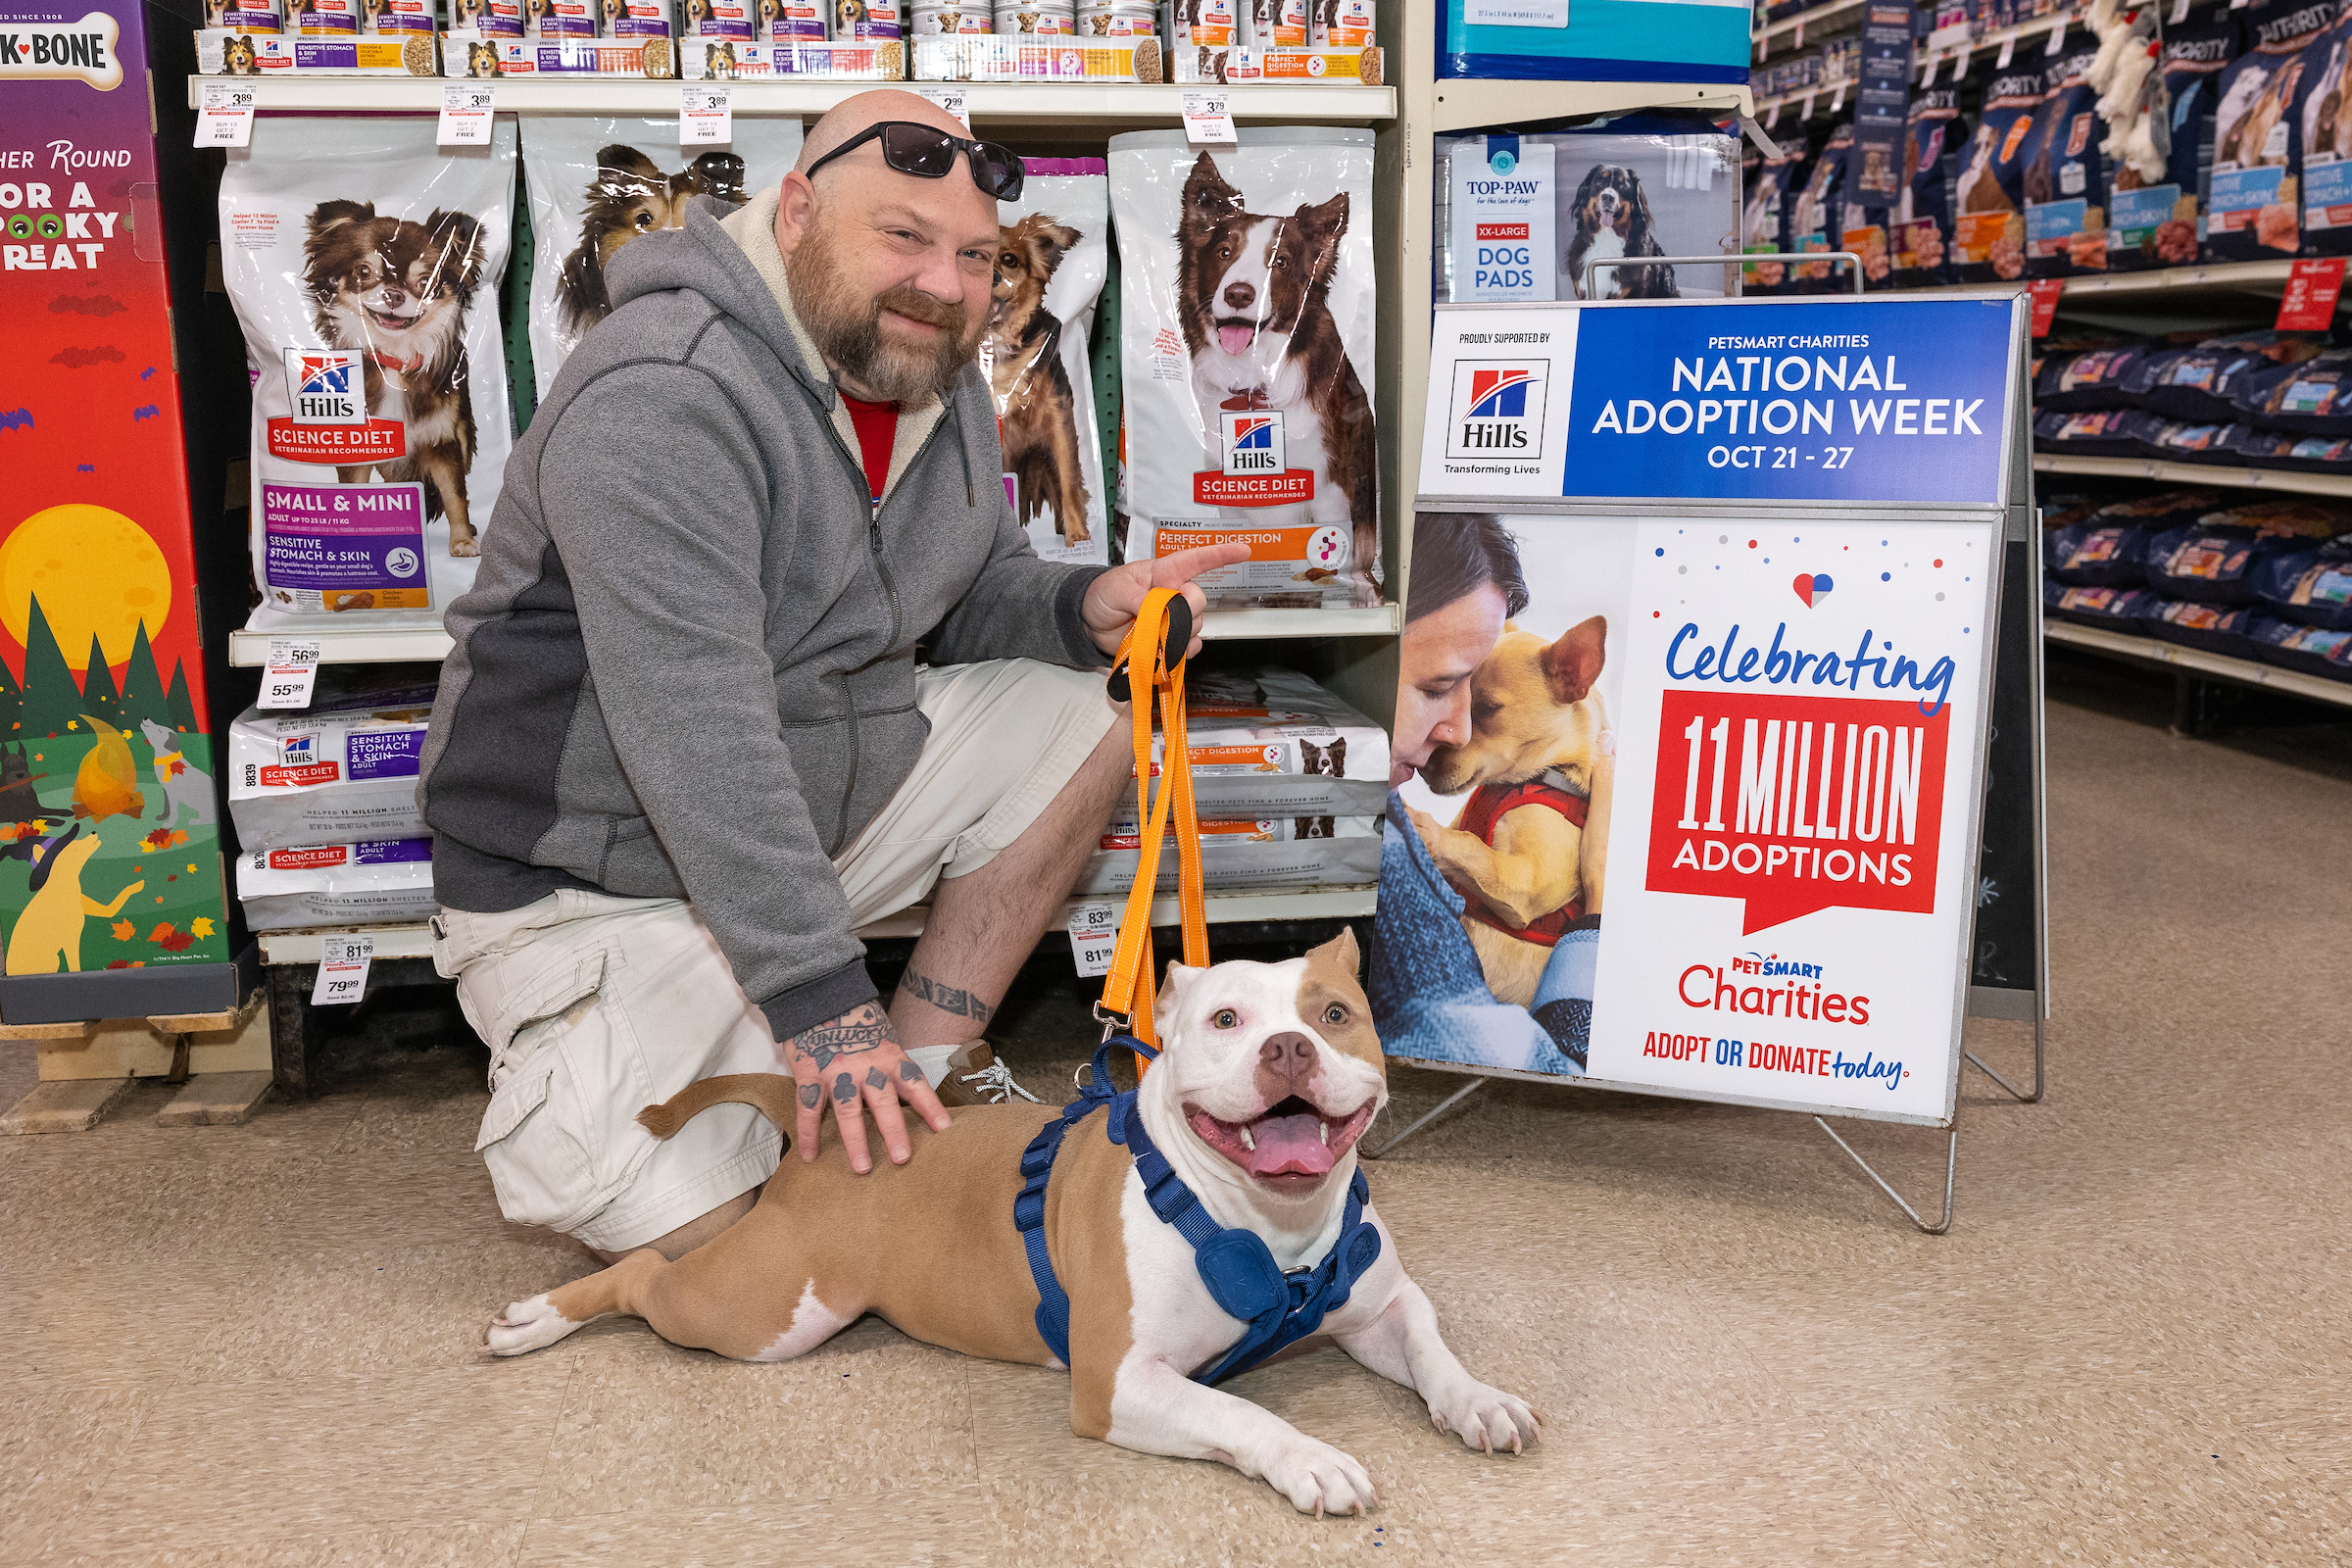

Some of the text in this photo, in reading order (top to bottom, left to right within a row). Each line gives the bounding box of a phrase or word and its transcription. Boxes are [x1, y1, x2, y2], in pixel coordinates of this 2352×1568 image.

[31, 33, 106, 69] BONE
[69, 181, 96, 209] A
[1479, 227, 1527, 236] XX-LARGE
[3, 243, 105, 270] REAT
[1479, 248, 1530, 266] DOG
[1476, 270, 1533, 288] PADS
[1459, 333, 1550, 344] PROUDLY SUPPORTED BY
[1708, 334, 1870, 350] PETSMART CHARITIES
[1671, 355, 1907, 392] NATIONAL
[299, 397, 354, 417] Hill's
[1592, 398, 1984, 436] ADOPTION WEEK
[273, 428, 394, 445] SCIENCE DIET
[1462, 423, 1528, 449] Hill's
[328, 446, 395, 455] RECOMMENDED
[1707, 445, 1767, 468] OCT
[1772, 446, 1797, 468] 21
[1823, 447, 1854, 469] 27
[1233, 452, 1276, 468] Hill's
[1445, 465, 1541, 475] Transforming Lives
[1201, 478, 1306, 492] SCIENCE DIET
[267, 491, 412, 512] SMALL & MINI
[268, 513, 289, 522] ADULT
[270, 536, 321, 549] SENSITIVE
[1159, 532, 1282, 544] PERFECT DIGESTION
[270, 547, 370, 562] STOMACH & SKIN
[1666, 622, 1956, 717] Celebrating
[351, 734, 412, 745] SENSITIVE
[351, 742, 410, 754] STOMACH
[285, 752, 313, 764] Hill's
[351, 752, 391, 762] & SKIN
[1209, 746, 1259, 755] DIGESTION
[246, 763, 256, 787] 8839
[266, 767, 333, 779] SCIENCE DIET
[1678, 715, 1925, 846] 11 MILLION
[274, 851, 341, 863] SCIENCE DIET
[1672, 838, 1912, 887] ADOPTIONS
[310, 895, 339, 904] HELPED
[1732, 956, 1823, 980] PETSMART
[1679, 964, 1870, 1025] Charities
[810, 1024, 887, 1046] UNLUCKY
[1643, 1031, 1711, 1063] ADOPT
[1715, 1039, 1742, 1067] OR
[1748, 1042, 1832, 1077] DONATE
